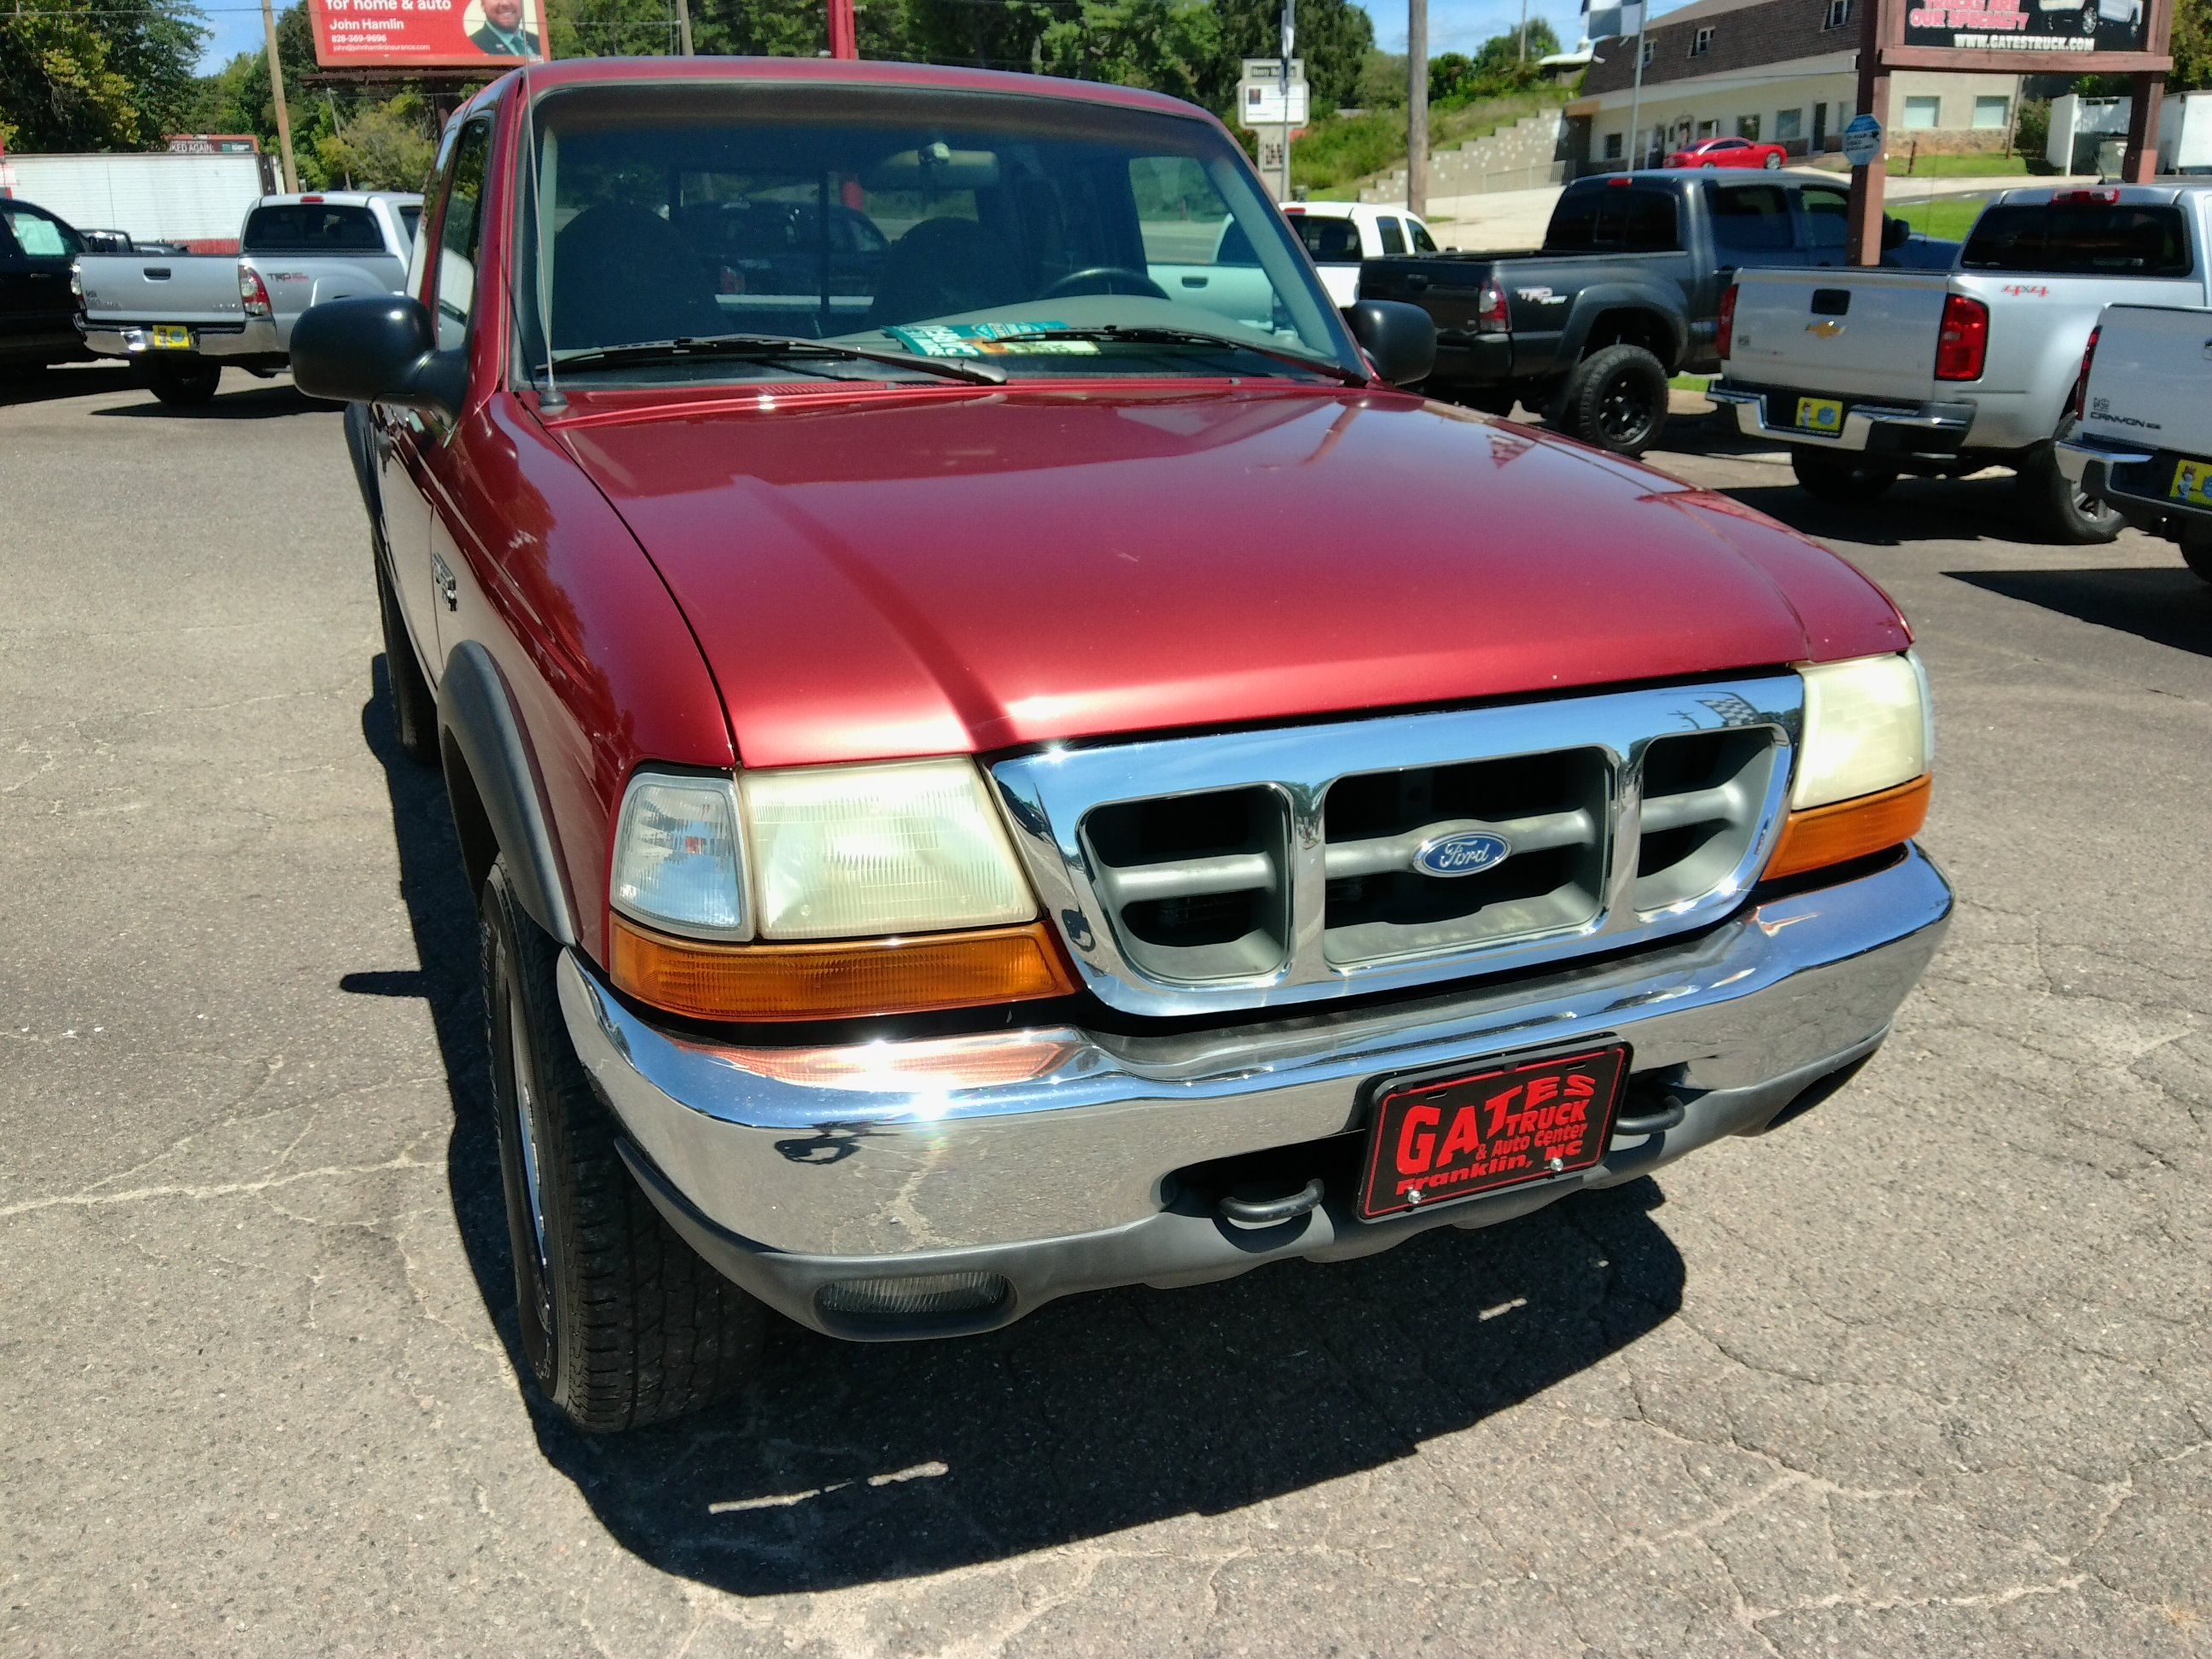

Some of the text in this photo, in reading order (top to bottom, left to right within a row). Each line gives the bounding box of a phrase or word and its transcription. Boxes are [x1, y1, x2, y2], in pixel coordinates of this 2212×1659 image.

[326, 0, 452, 10] for home & auto
[329, 18, 405, 31] John Hamlin
[1909, 9, 2029, 31] OUR SPECIALTY
[1953, 33, 2095, 51] WWW.GATESTRUCK.COM
[2091, 410, 2145, 428] CANYON
[1440, 840, 1491, 868] Ford
[1395, 1074, 1597, 1175] GATES
[1505, 1098, 1591, 1137] TRUCK
[1476, 1144, 1487, 1161] &
[1493, 1135, 1530, 1156] Auto
[1395, 1140, 1583, 1196] Franklin, NC
